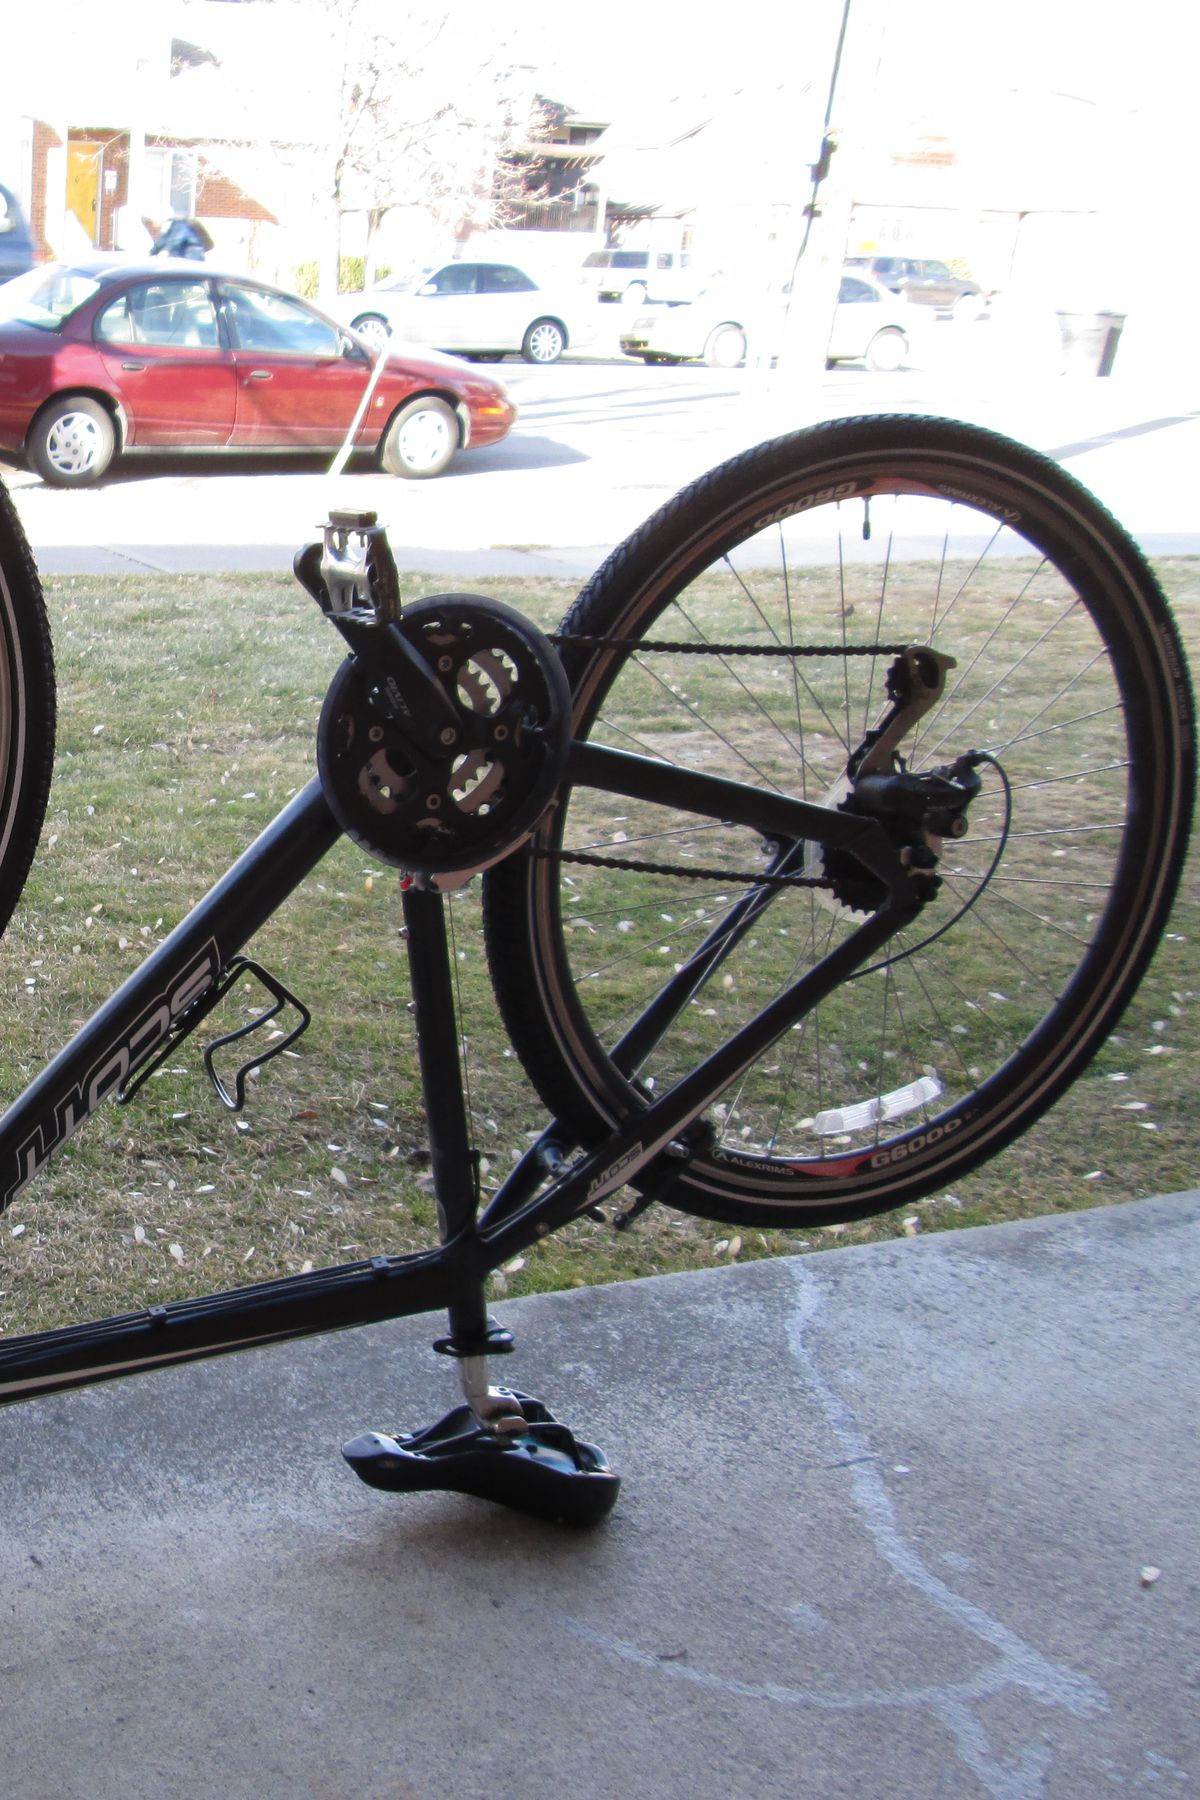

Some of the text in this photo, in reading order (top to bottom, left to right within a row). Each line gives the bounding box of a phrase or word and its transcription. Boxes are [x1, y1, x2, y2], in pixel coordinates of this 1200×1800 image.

[753, 482, 857, 529] G6000
[729, 1156, 796, 1176] ALEXRIMS
[870, 1118, 961, 1169] G6000
